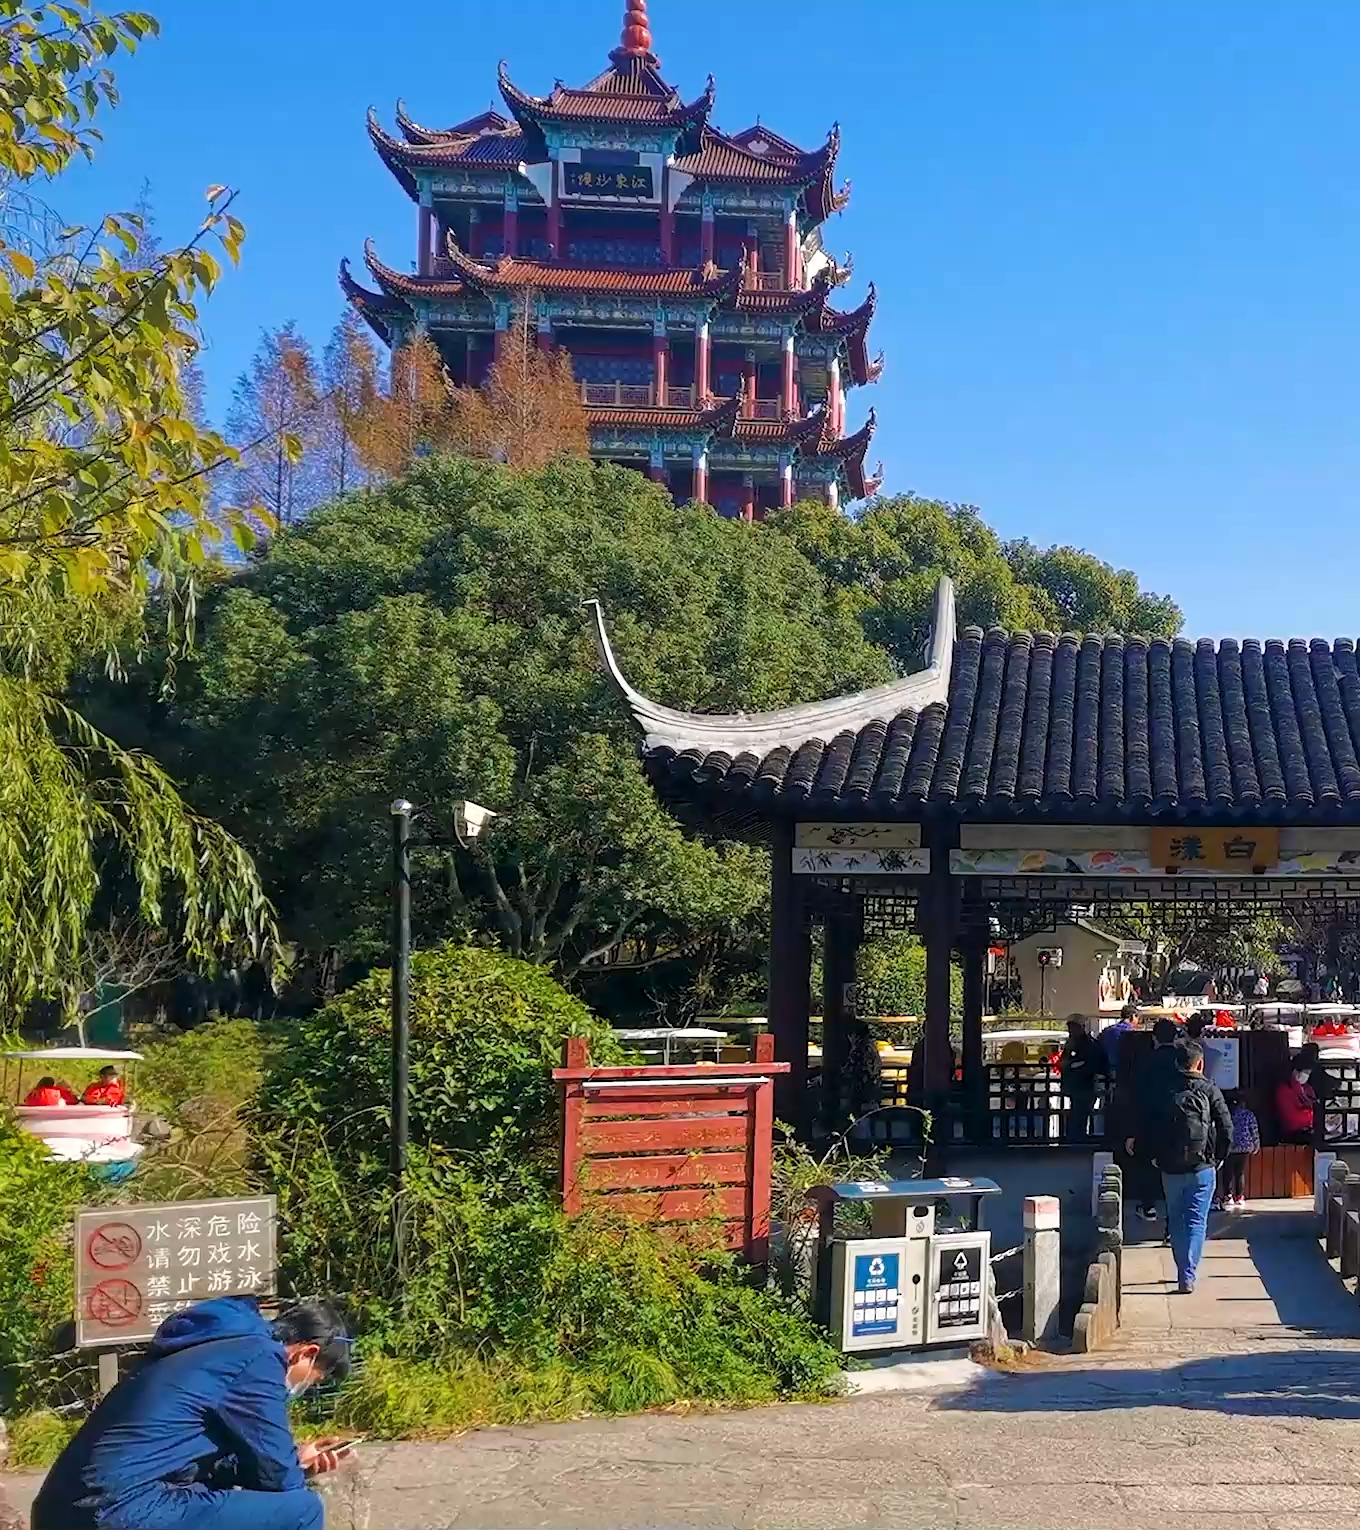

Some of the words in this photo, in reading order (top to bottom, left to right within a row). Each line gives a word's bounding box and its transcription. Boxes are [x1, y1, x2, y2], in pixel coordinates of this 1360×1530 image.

[147, 1211, 262, 1242] 水深危险
[146, 1240, 261, 1269] 请勿戏水
[147, 1267, 263, 1297] 禁止游泳
